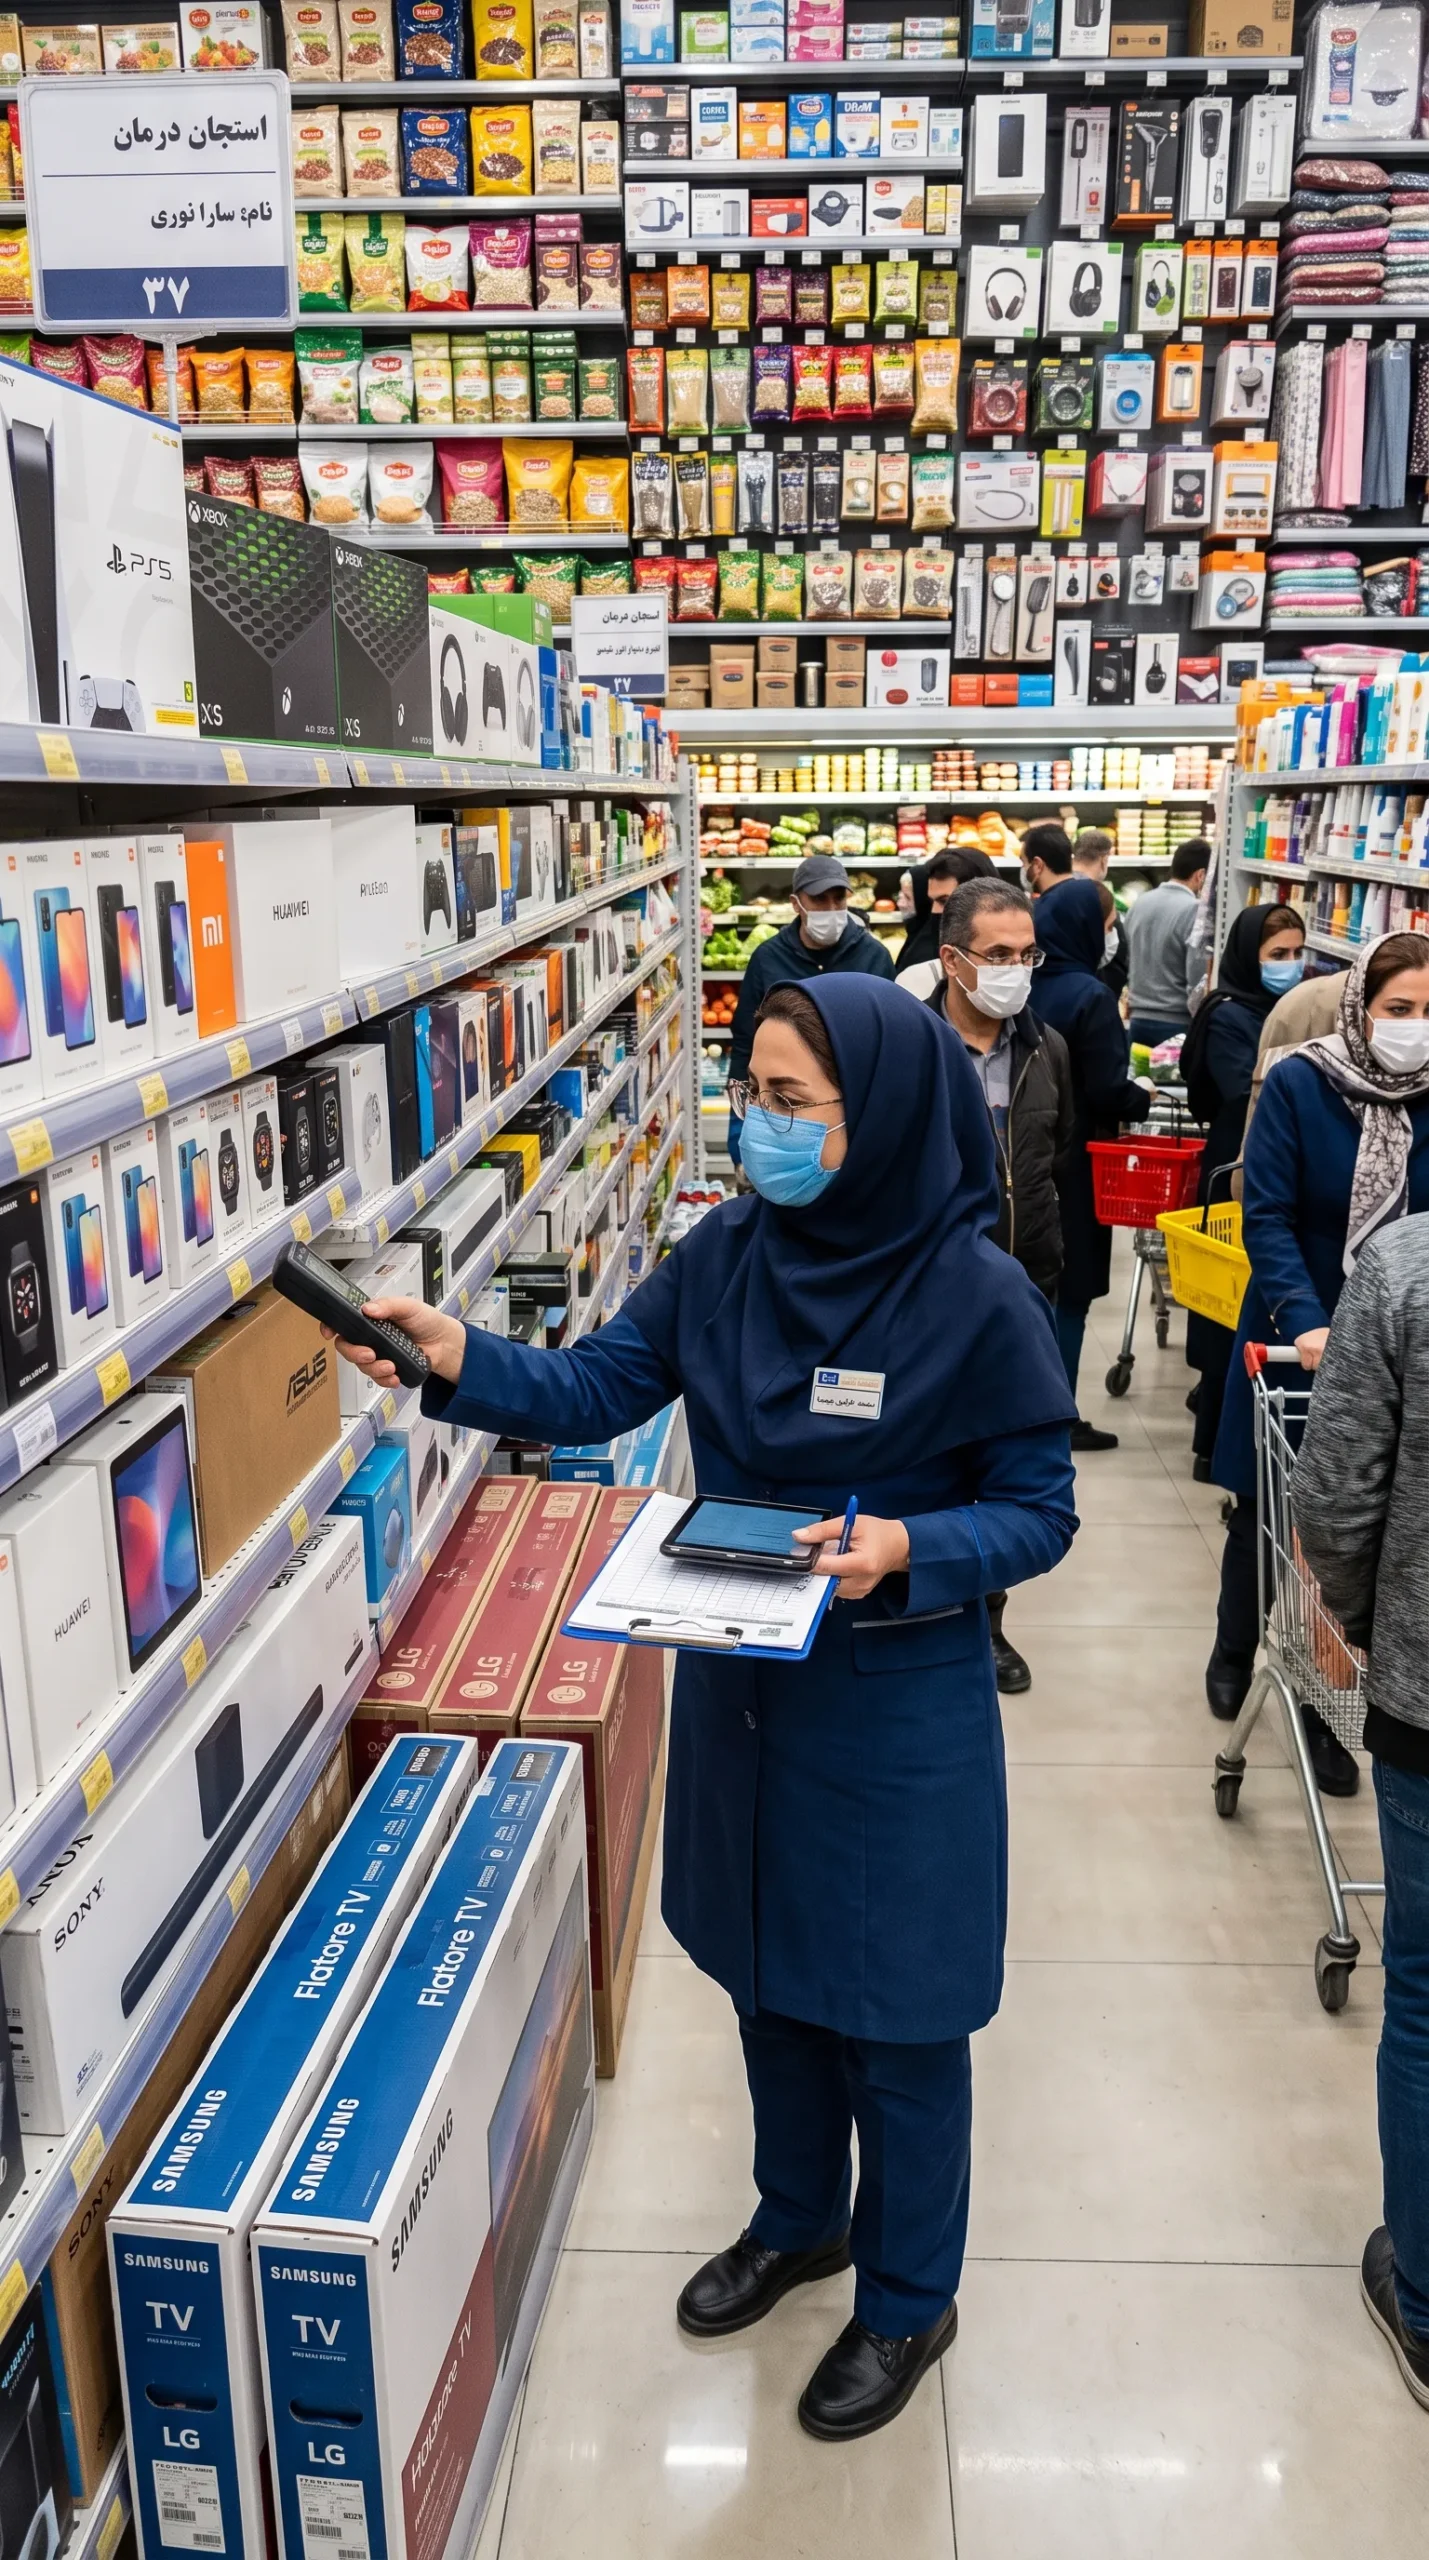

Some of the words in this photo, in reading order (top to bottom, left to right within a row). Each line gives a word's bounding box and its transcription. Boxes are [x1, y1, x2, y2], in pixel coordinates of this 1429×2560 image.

[114, 116, 181, 151] درمان
[189, 114, 267, 150] استجان
[151, 202, 195, 229] نوری
[141, 276, 190, 314] ۳۷
[202, 507, 229, 528] XBOX
[130, 552, 172, 581] PS5
[53, 1596, 91, 1642] HUAWEI
[391, 1647, 423, 1668] LG
[472, 1656, 503, 1677] LG
[559, 1660, 588, 1682] LG
[54, 1876, 104, 1953] SONY
[336, 1889, 371, 1916] TV
[454, 1896, 488, 1923] TV
[151, 2089, 228, 2193] SAMSUNG
[291, 2098, 360, 2202] SAMSUNG
[390, 2107, 454, 2274] SAMSUNG
[68, 2164, 114, 2262] SONY
[123, 2252, 210, 2275] SAMSUNG
[270, 2265, 357, 2288] SAMSUNG
[145, 2300, 195, 2332] TV
[291, 2313, 342, 2347] TV
[162, 2425, 201, 2450] LG
[307, 2441, 346, 2465] LG
